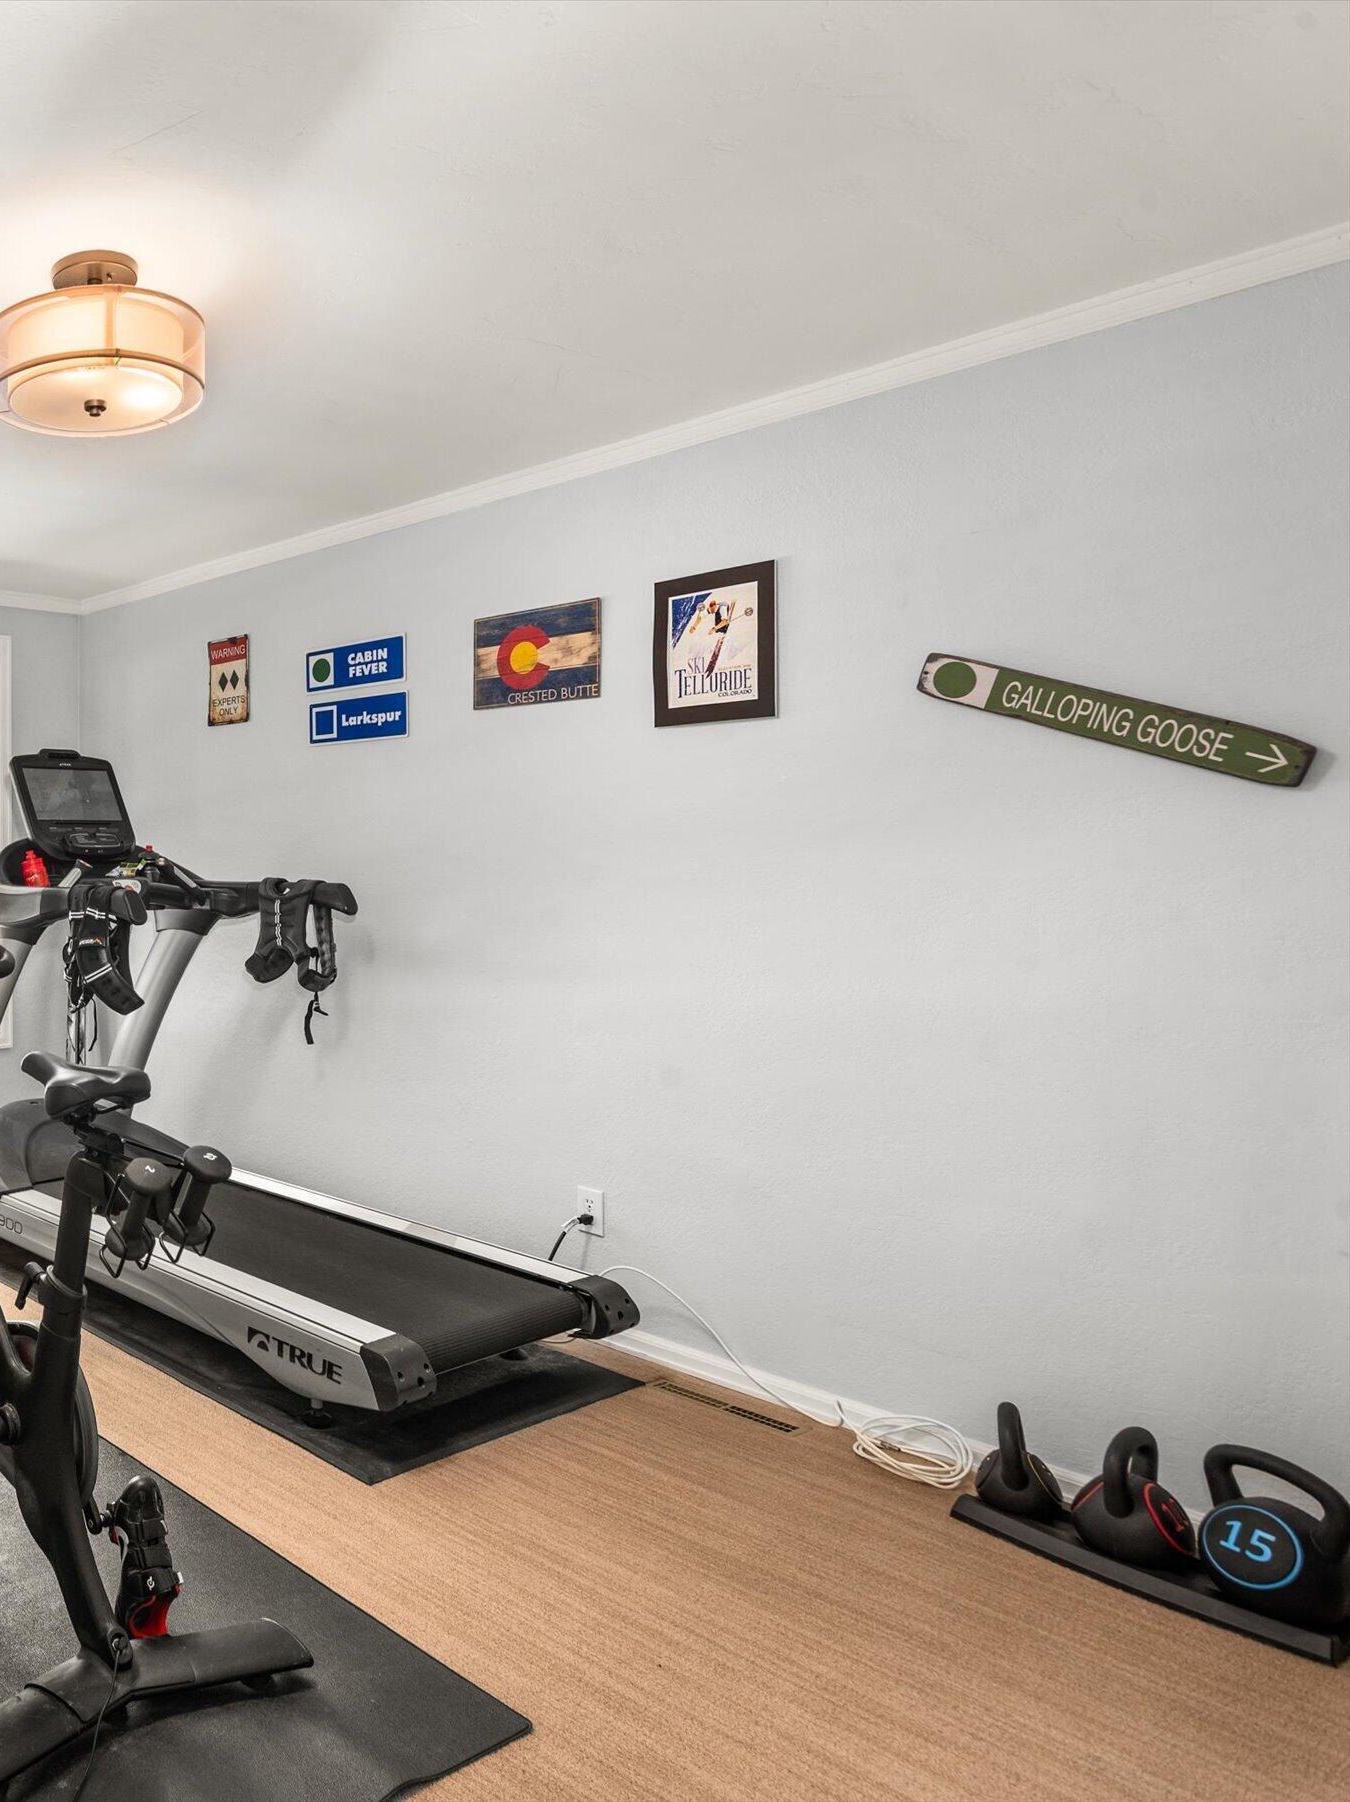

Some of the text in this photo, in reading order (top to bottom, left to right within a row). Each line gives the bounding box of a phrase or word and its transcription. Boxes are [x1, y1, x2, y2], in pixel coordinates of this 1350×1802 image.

[211, 644, 246, 660] WARNING
[347, 648, 388, 665] CABIN
[348, 661, 388, 678] FEVER
[687, 657, 705, 674] SKI
[674, 668, 752, 699] TELLURIDE
[212, 695, 246, 708] EXPERTS
[507, 683, 599, 705] CRESTED BUTTE
[718, 689, 753, 698] COLORADO
[219, 706, 238, 717] ONLY
[341, 710, 402, 727] Larkspur
[1002, 681, 1234, 762] GALLOPING GOOSE
[271, 1336, 343, 1385] TRUE
[1218, 1520, 1277, 1563] 15
